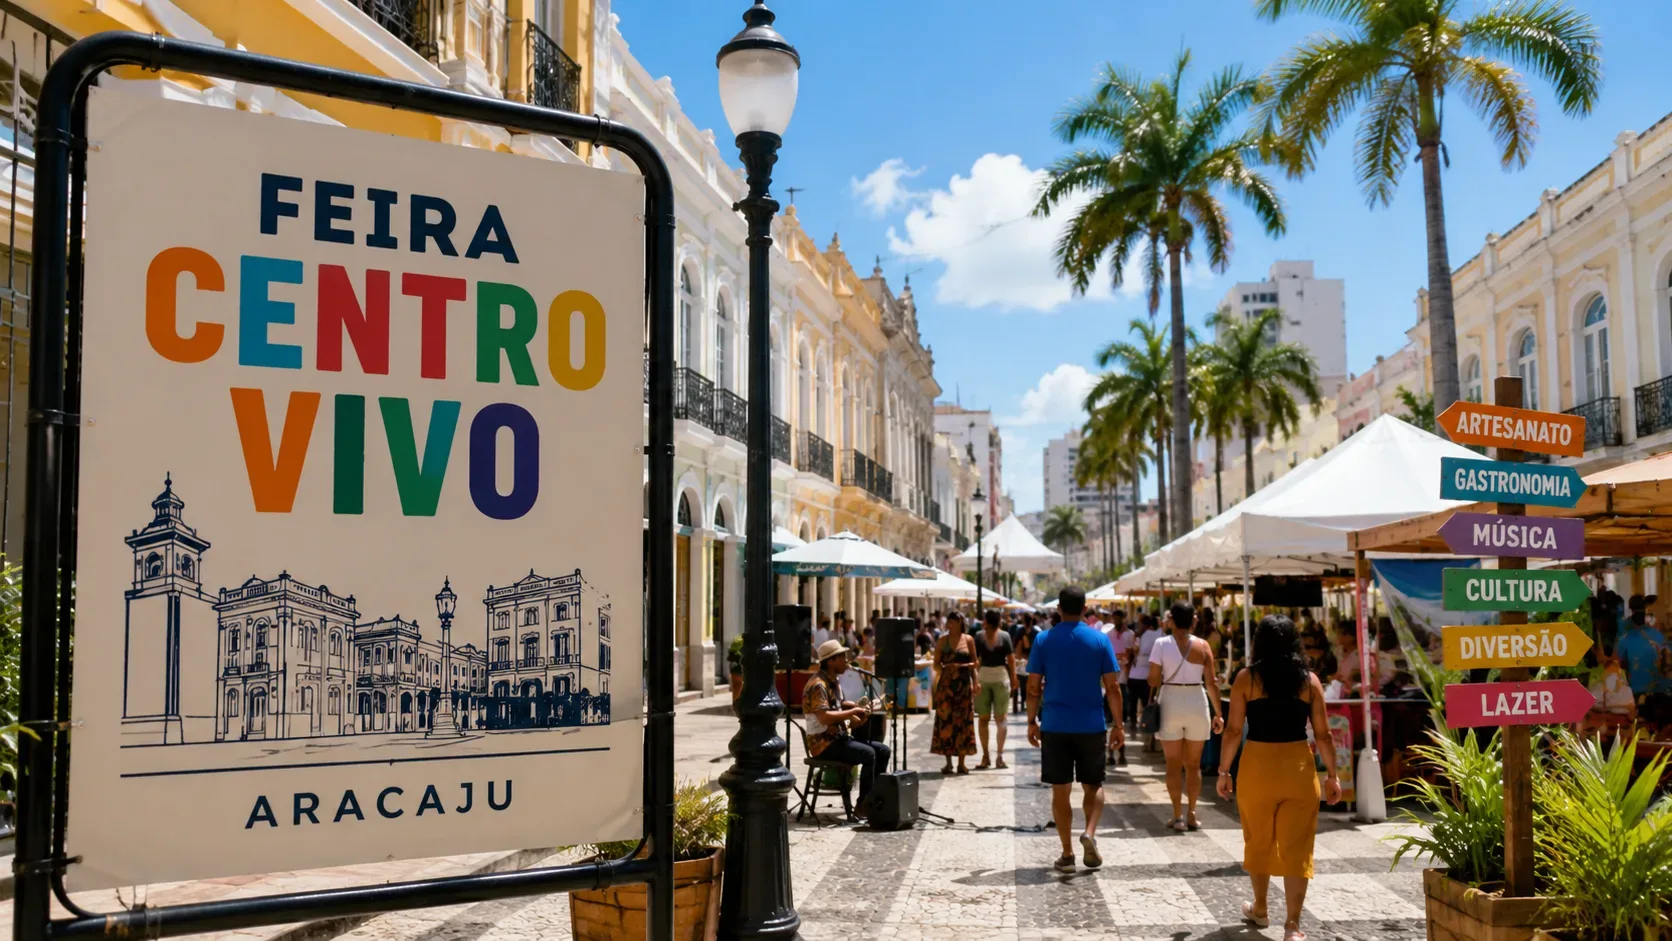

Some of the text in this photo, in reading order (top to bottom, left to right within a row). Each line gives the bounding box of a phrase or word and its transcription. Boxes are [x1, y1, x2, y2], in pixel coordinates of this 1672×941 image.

[260, 172, 519, 263] FEIRA
[145, 246, 606, 391] CENTRO
[1456, 411, 1572, 446] ARTESANATO
[229, 387, 539, 520] VIVO
[1454, 467, 1571, 498] GASTRONOMIA
[1473, 518, 1557, 550] MÚSICA
[1466, 578, 1563, 603] CULTURA
[1460, 629, 1567, 660] DIVERSÃO
[1481, 690, 1554, 717] LAZER
[244, 779, 513, 829] ARACAJU
